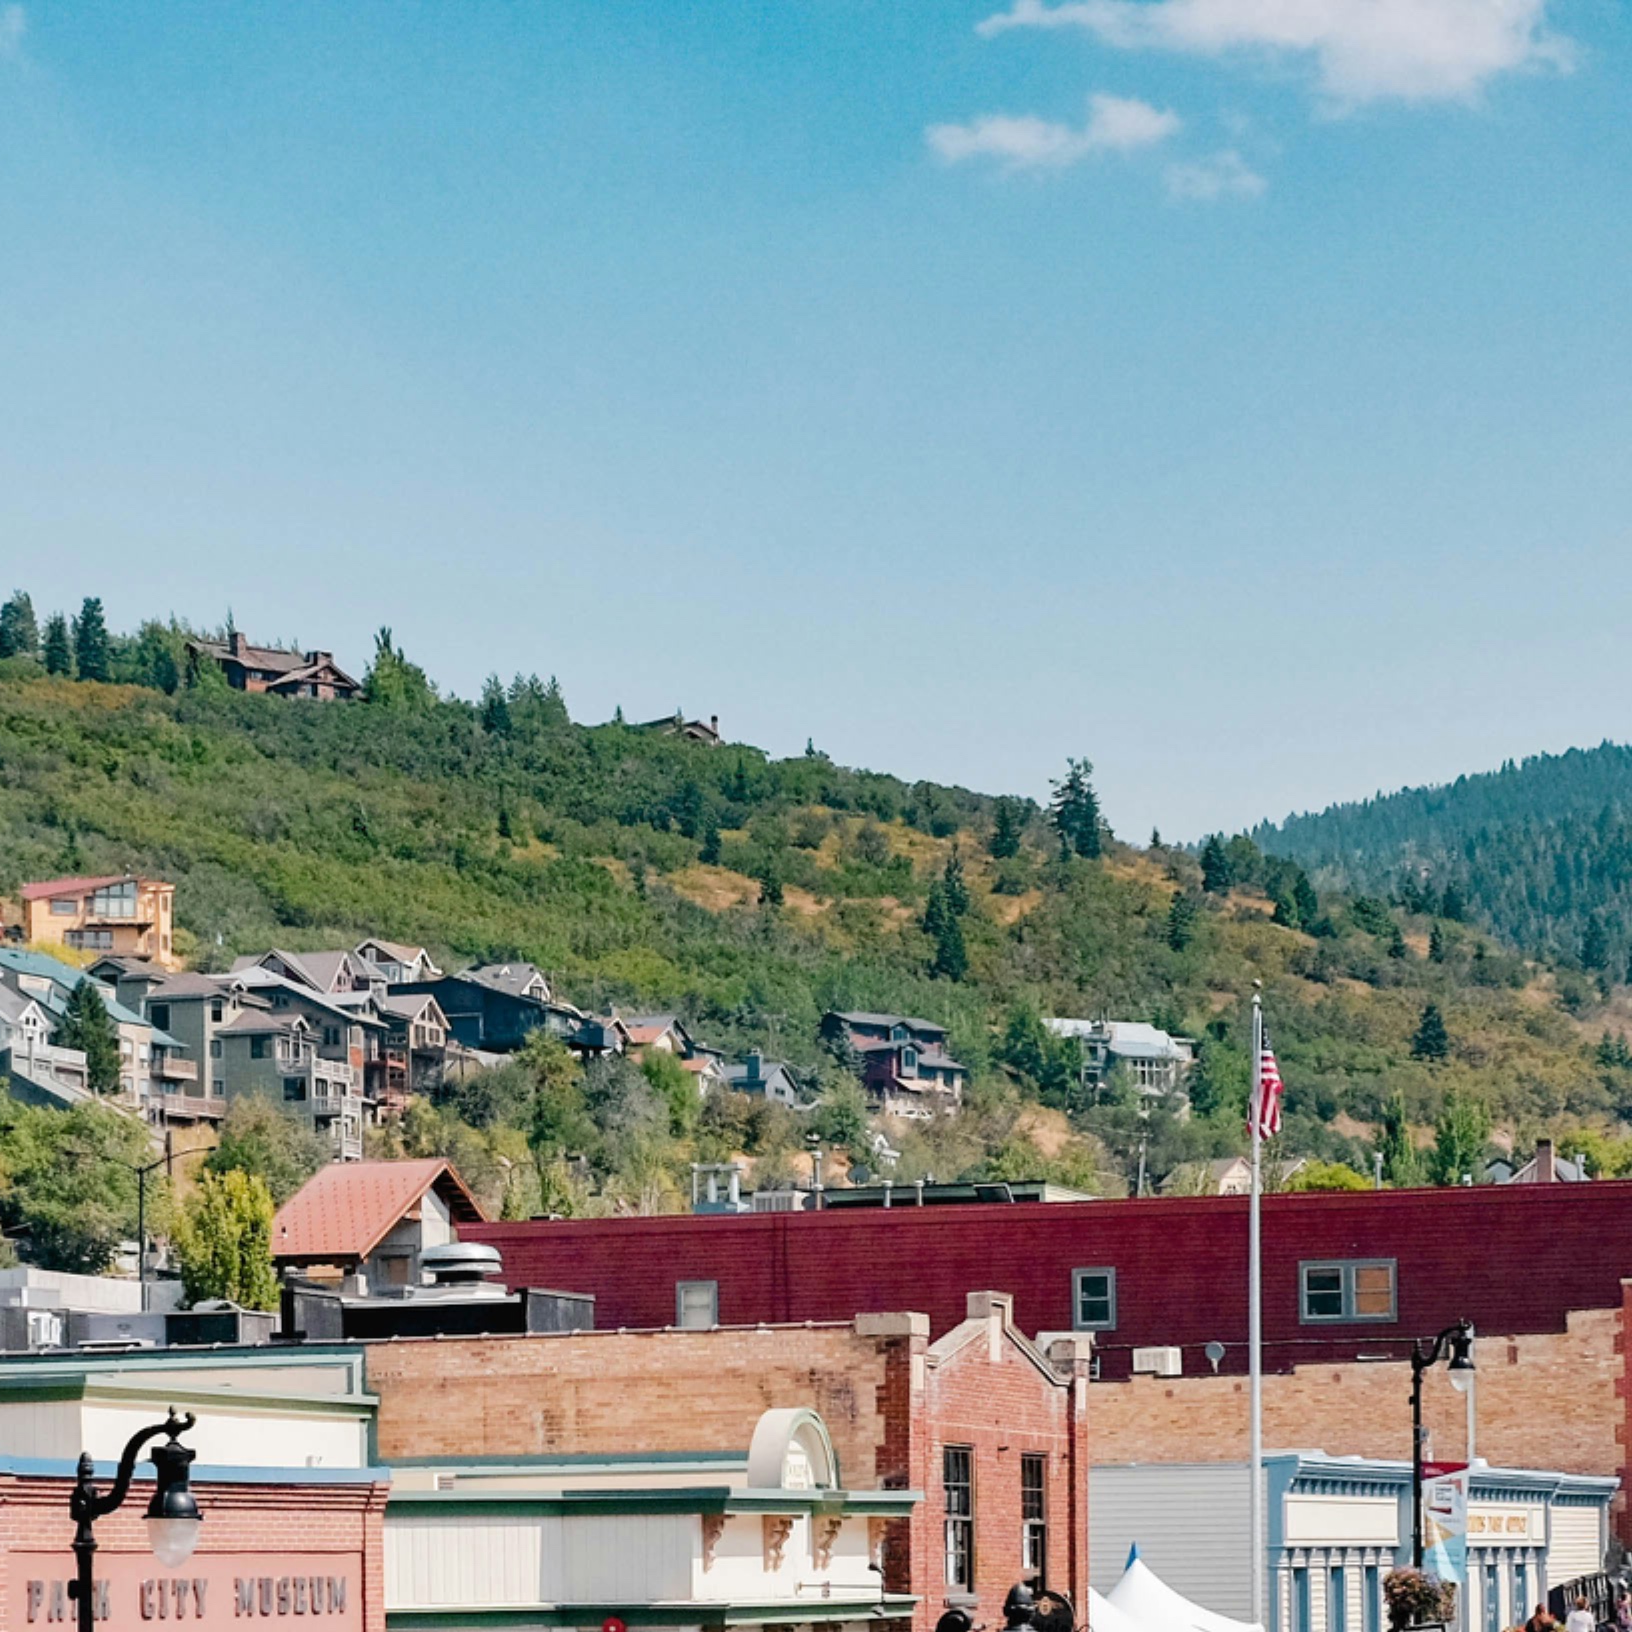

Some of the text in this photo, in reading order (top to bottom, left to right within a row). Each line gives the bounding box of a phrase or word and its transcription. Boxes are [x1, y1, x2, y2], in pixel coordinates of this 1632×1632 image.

[26, 1575, 346, 1623] PAK CITY MUSEUM
